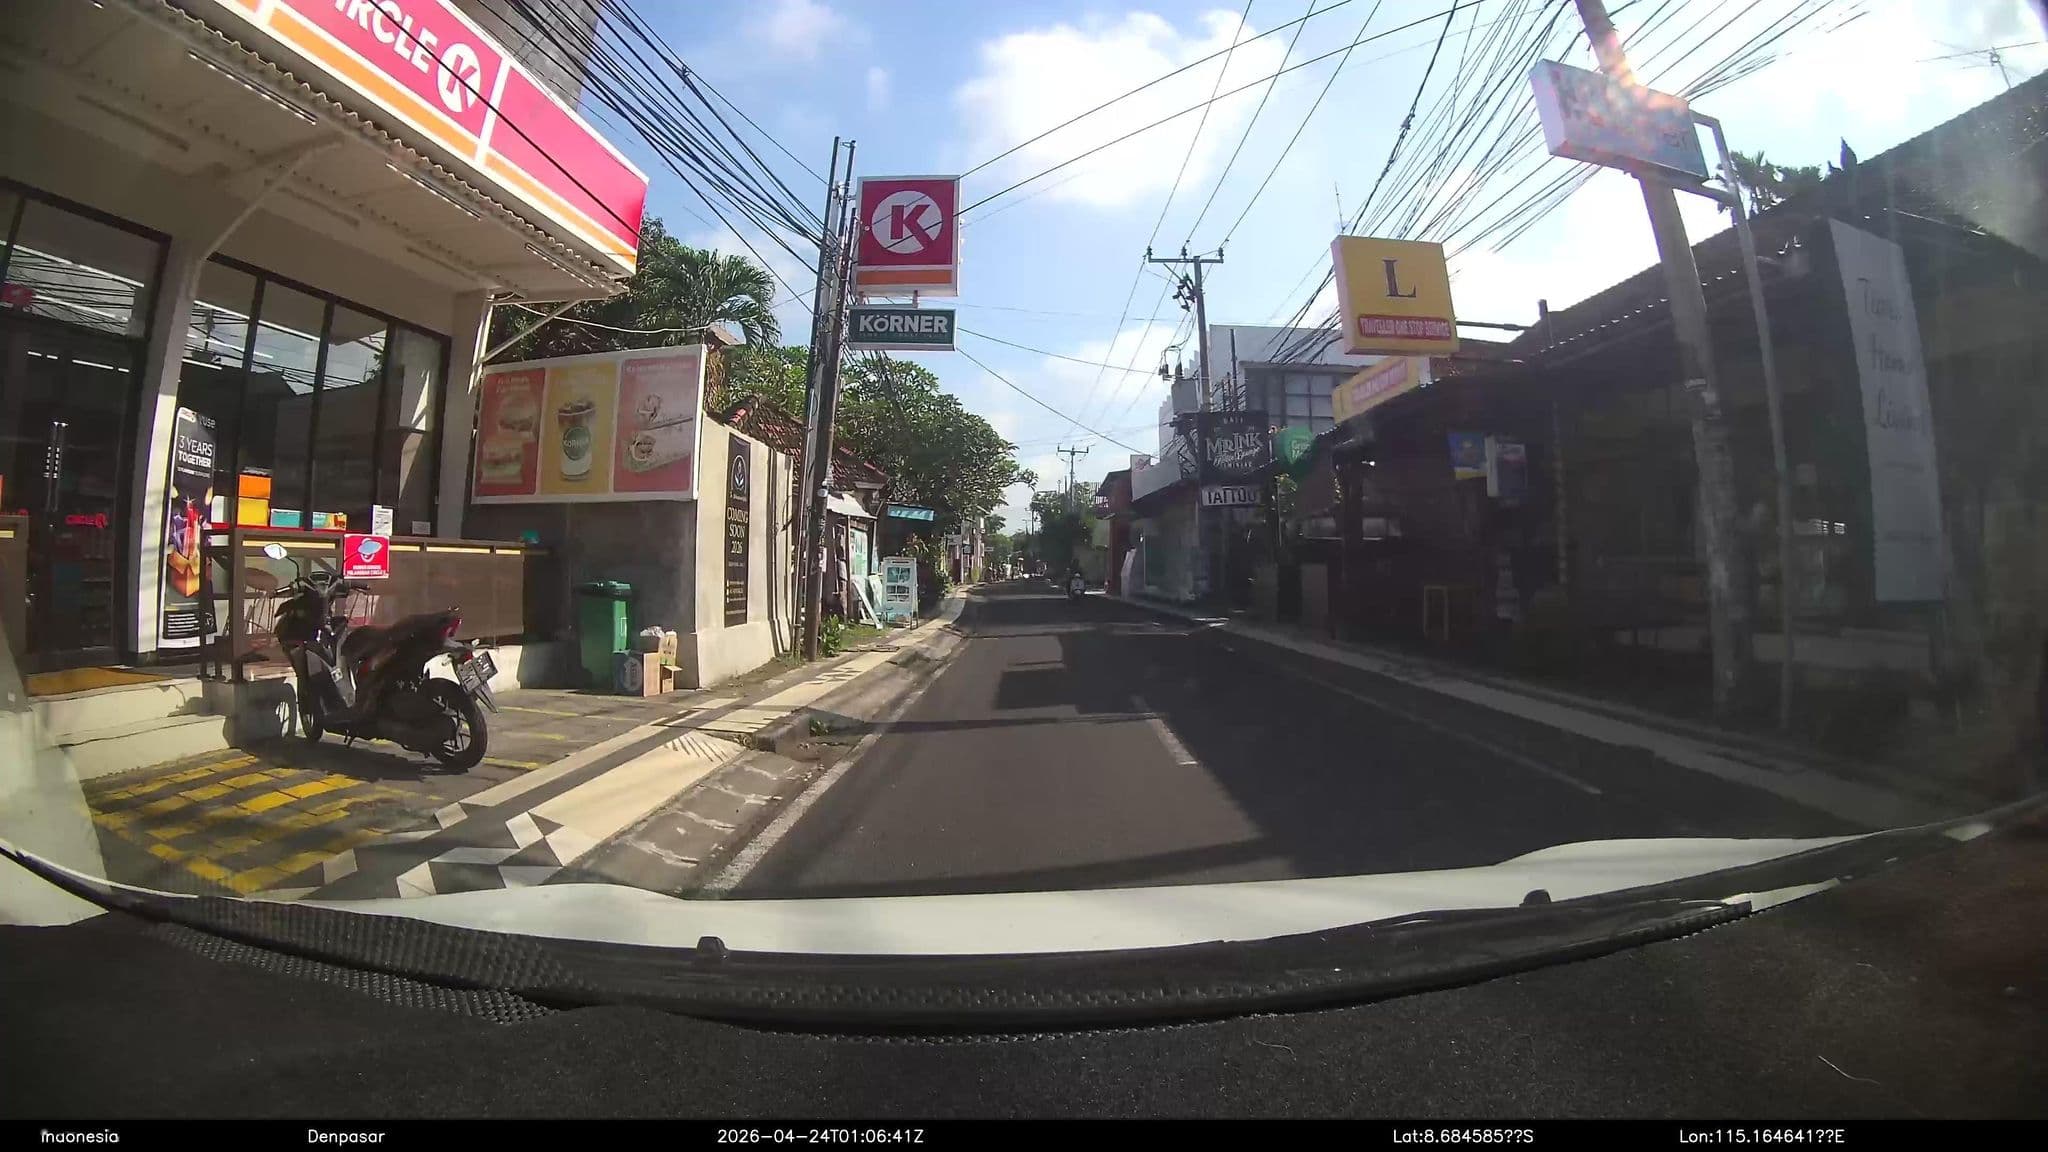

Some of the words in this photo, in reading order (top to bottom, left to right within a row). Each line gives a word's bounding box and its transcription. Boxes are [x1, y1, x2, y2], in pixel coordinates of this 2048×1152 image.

[890, 203, 938, 250] K
[1383, 259, 1416, 298] L
[178, 435, 185, 449] 3
[187, 438, 213, 457] YEARS
[178, 450, 212, 467] TOGETHER
[727, 507, 748, 524] COMING
[729, 525, 746, 538] SOON
